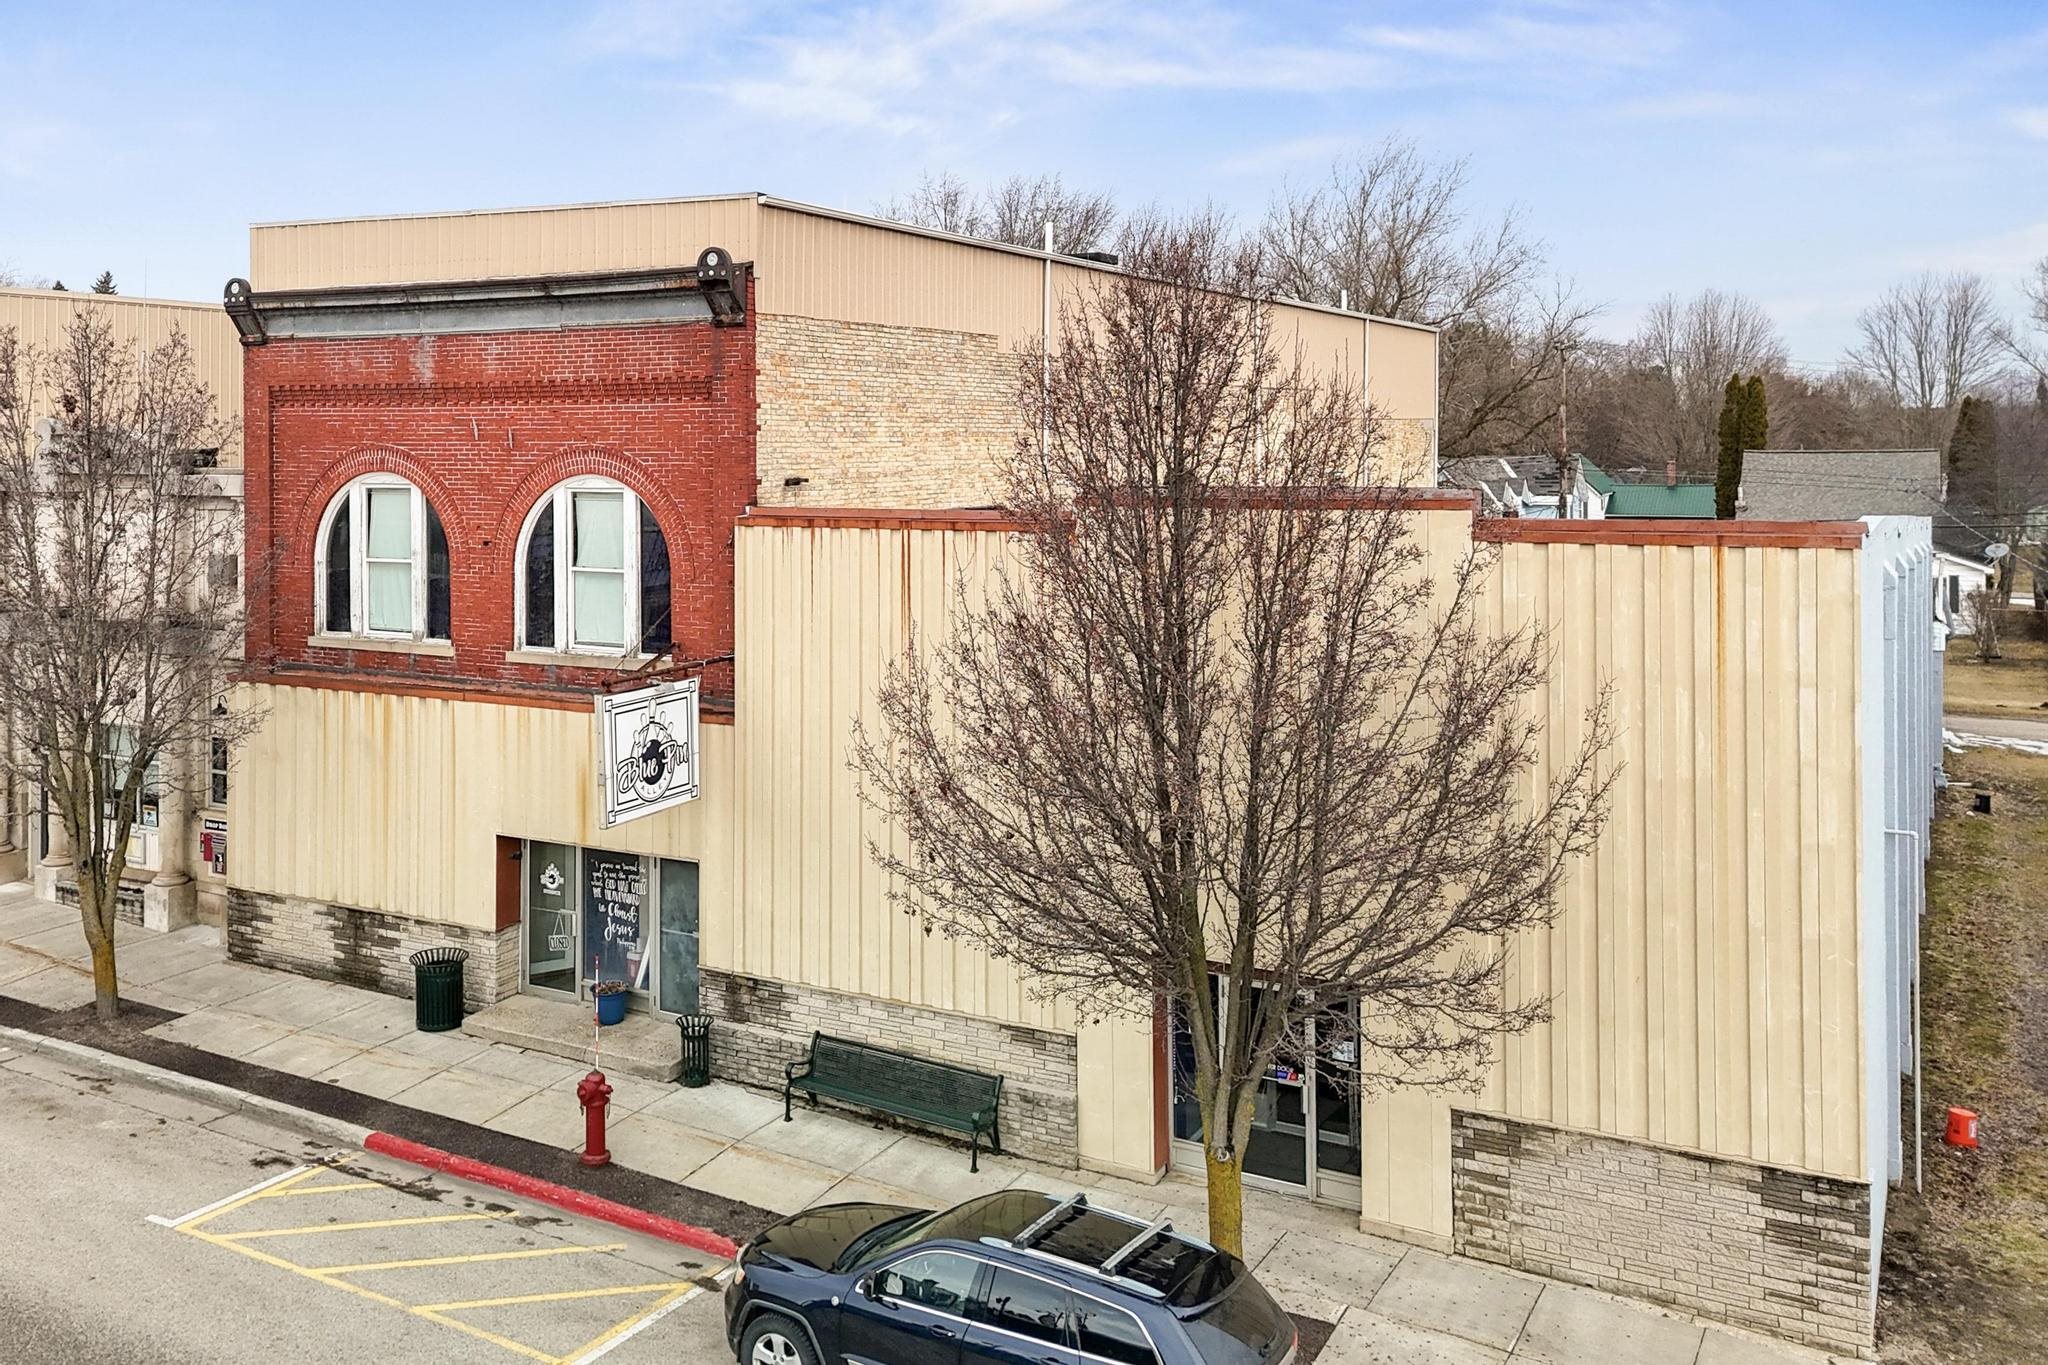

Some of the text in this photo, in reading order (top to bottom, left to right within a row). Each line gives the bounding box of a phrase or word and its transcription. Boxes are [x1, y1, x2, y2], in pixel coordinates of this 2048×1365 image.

[617, 739, 689, 794] Blue Pin
[641, 776, 667, 795] ALLEY
[607, 902, 638, 924] Christ
[549, 936, 569, 949] CLOSED
